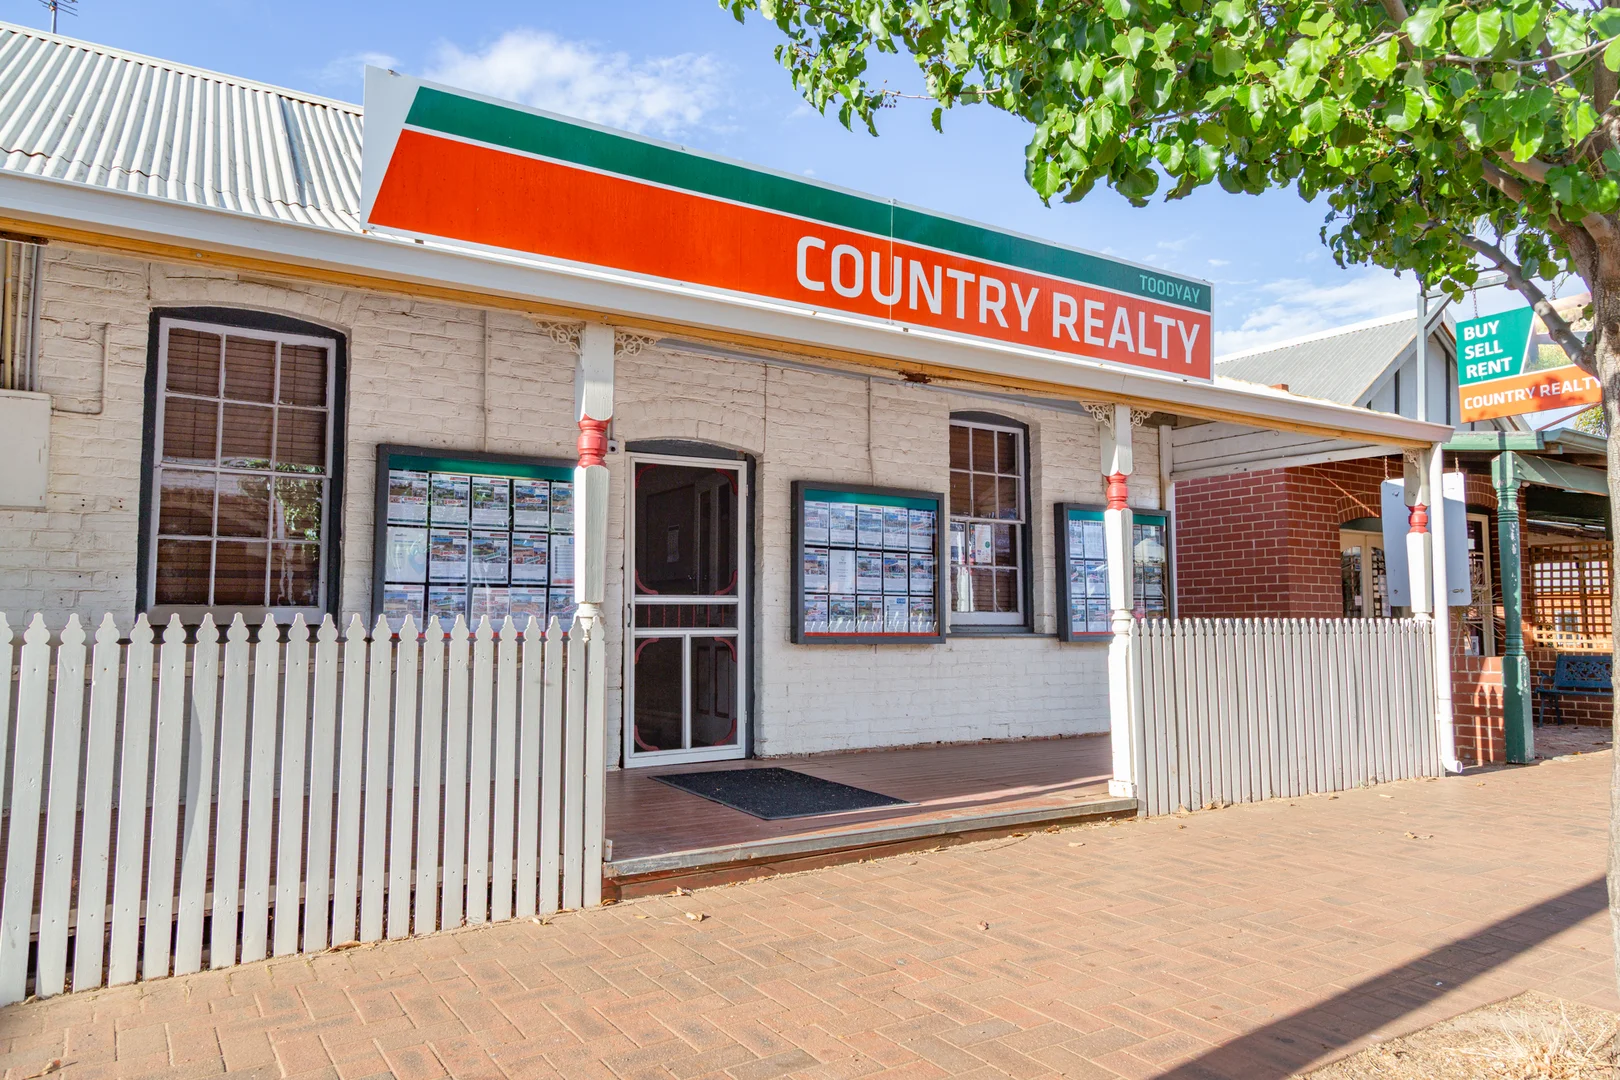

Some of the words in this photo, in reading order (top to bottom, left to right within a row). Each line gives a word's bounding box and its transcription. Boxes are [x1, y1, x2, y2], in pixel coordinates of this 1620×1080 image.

[796, 235, 1039, 332] COUNTRY
[1052, 291, 1200, 364] REALTY
[1139, 274, 1200, 304] TOODYAY
[1463, 319, 1500, 341] BUY
[1464, 339, 1504, 360] SELL
[1466, 356, 1513, 379] RENT
[1464, 385, 1536, 410] COUNTRY
